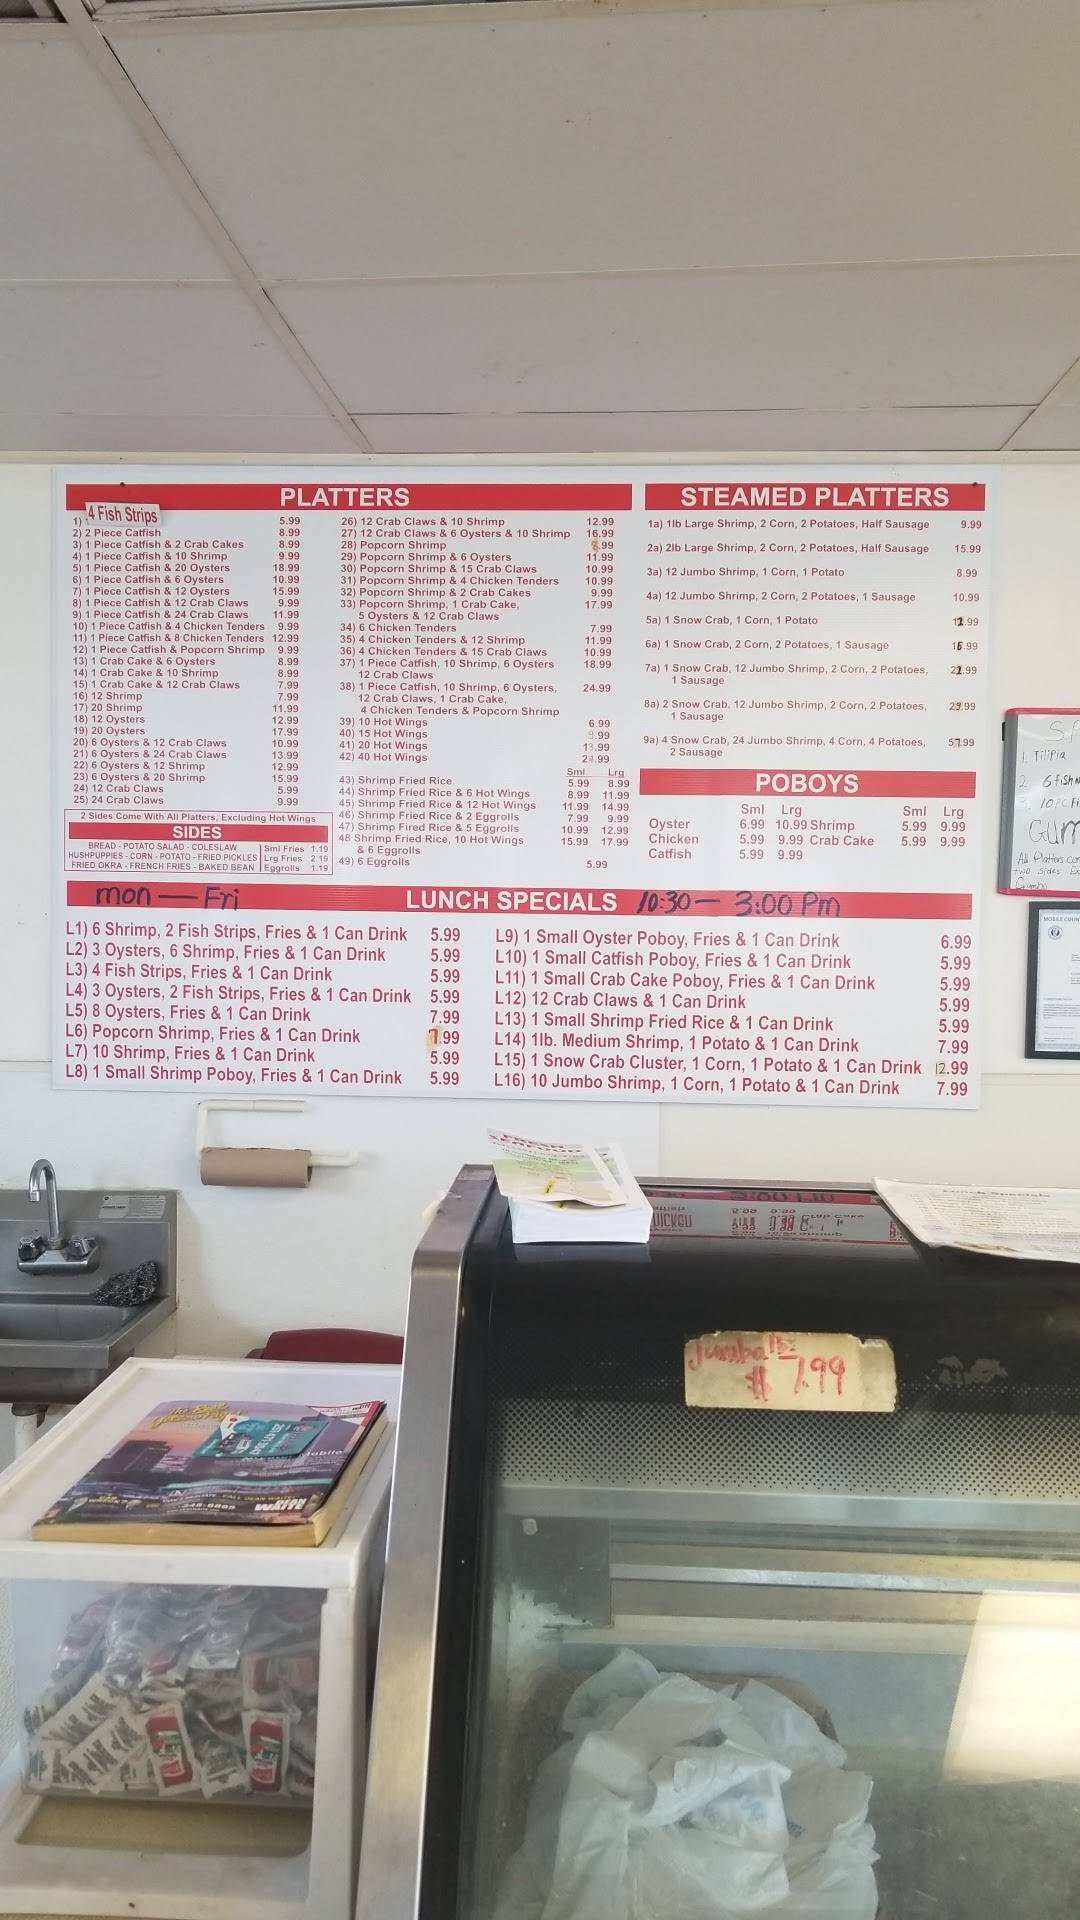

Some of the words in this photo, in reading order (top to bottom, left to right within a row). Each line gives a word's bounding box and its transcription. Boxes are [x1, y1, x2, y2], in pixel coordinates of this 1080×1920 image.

[280, 487, 410, 507] PLATTERS
[680, 486, 806, 506] STEAMED
[815, 486, 949, 507] PLATTERS
[73, 516, 82, 527] 1)
[279, 516, 301, 526] 5.99
[88, 505, 95, 520] 4
[97, 505, 122, 521] Fish
[124, 506, 158, 526] Strips
[340, 516, 357, 528] 26)
[360, 516, 372, 526] 12
[375, 516, 401, 526] Crab
[404, 516, 436, 526] Claws
[439, 517, 448, 526] &
[450, 517, 463, 526] 10
[466, 516, 505, 528] Shrimp
[586, 516, 614, 526] 12.99
[648, 519, 663, 530] 1a)
[666, 519, 682, 528] 1lb
[684, 519, 714, 530] Large
[717, 518, 757, 530] Shrimp,
[760, 519, 766, 528] 2
[769, 518, 797, 529] Corn,
[800, 519, 806, 528] 2
[809, 519, 858, 529] Potatoes,
[861, 519, 882, 528] Half
[885, 519, 930, 531] Sausage
[960, 519, 982, 529] 9.99
[72, 528, 82, 539] 2)
[84, 528, 91, 537] 2
[94, 528, 122, 537] Piece
[124, 528, 161, 537] Catfish
[278, 528, 300, 537] 8.99
[72, 563, 82, 574] 5)
[85, 563, 90, 572] 1
[93, 563, 122, 572] Piece
[124, 563, 160, 572] Catfish
[164, 562, 172, 572] &
[174, 563, 187, 572] 20
[189, 563, 230, 574] Oysters
[272, 563, 300, 572] 18.99
[339, 716, 355, 727] 39)
[358, 717, 370, 726] 10
[373, 717, 392, 726] Hot
[394, 717, 428, 729] Wings
[588, 719, 610, 728] 6.99
[566, 767, 586, 776] Sml
[608, 768, 625, 778] Lrg
[338, 775, 354, 786] 43)
[358, 775, 396, 787] Shrimp
[398, 776, 426, 785] Fried
[428, 776, 452, 785] Rice
[567, 778, 590, 788] 5.99
[607, 779, 630, 788] 8.99
[755, 772, 858, 793] POBOYS
[73, 794, 88, 806] 25)
[91, 795, 103, 804] 24
[106, 795, 130, 804] Crab
[133, 795, 164, 804] Claws
[277, 797, 298, 806] 9.99
[80, 811, 86, 820] 2
[88, 811, 113, 820] Sides
[115, 811, 142, 820] Come
[143, 812, 164, 820] With
[166, 812, 178, 821] All
[181, 812, 218, 821] Platters,
[221, 813, 266, 824] Excluding
[269, 814, 285, 822] Hot
[287, 814, 316, 824] Wings
[740, 803, 764, 815] Sml
[781, 804, 802, 818] Lrg
[902, 805, 926, 817] Sml
[943, 805, 964, 820] Lrg
[648, 817, 690, 832] Oyster
[739, 818, 764, 830] 6.99
[775, 819, 808, 830] 10.99
[810, 819, 855, 833] Shrimp
[901, 820, 927, 832] 5.99
[940, 821, 966, 832] 9.99
[172, 825, 222, 839] SIDES
[648, 832, 698, 844] Chicken
[739, 833, 764, 845] 5.99
[778, 834, 803, 845] 9.99
[809, 834, 839, 846] Crab
[843, 834, 874, 846] Cake
[900, 835, 926, 847] 5.99
[940, 836, 966, 847] 9.99
[263, 844, 280, 852] Sml
[282, 844, 304, 852] Fries
[310, 844, 328, 852] 1.19
[648, 847, 692, 859] Catfish
[739, 848, 764, 860] 5.99
[777, 849, 803, 860] 9.99
[264, 864, 300, 874] Eggrolls
[311, 864, 328, 872] 1.19
[338, 856, 354, 866] 49)
[357, 856, 364, 866] 6
[366, 856, 410, 868] Eggrolls
[586, 859, 608, 869] 5.99
[204, 886, 239, 912] Fri
[406, 889, 488, 910] LUNCH
[496, 890, 617, 912] SPECIALS
[636, 890, 691, 914] 10:30
[735, 890, 792, 917] 3:00
[66, 920, 88, 939] L1)
[92, 921, 100, 936] 6
[104, 921, 160, 940] Shrimp,
[165, 922, 173, 937] 2
[178, 922, 208, 938] Fish
[214, 923, 260, 942] Strips,
[265, 924, 302, 939] Fries
[306, 924, 317, 940] &
[322, 925, 328, 939] 1
[334, 925, 363, 940] Can
[368, 926, 407, 941] Drink
[430, 927, 460, 942] 5.99
[494, 1072, 525, 1090] L16)
[530, 1072, 547, 1087] 10
[551, 1073, 602, 1088] Jumbo
[607, 1074, 664, 1093] Shrimp,
[670, 1076, 676, 1090] 1
[683, 1076, 724, 1093] Corn,
[729, 1077, 735, 1091] 1
[742, 1077, 790, 1092] Potato
[795, 1078, 806, 1093] &
[811, 1078, 818, 1093] 1
[824, 1078, 854, 1094] Can
[859, 1079, 900, 1095] Drink
[936, 1081, 968, 1096] 7.99
